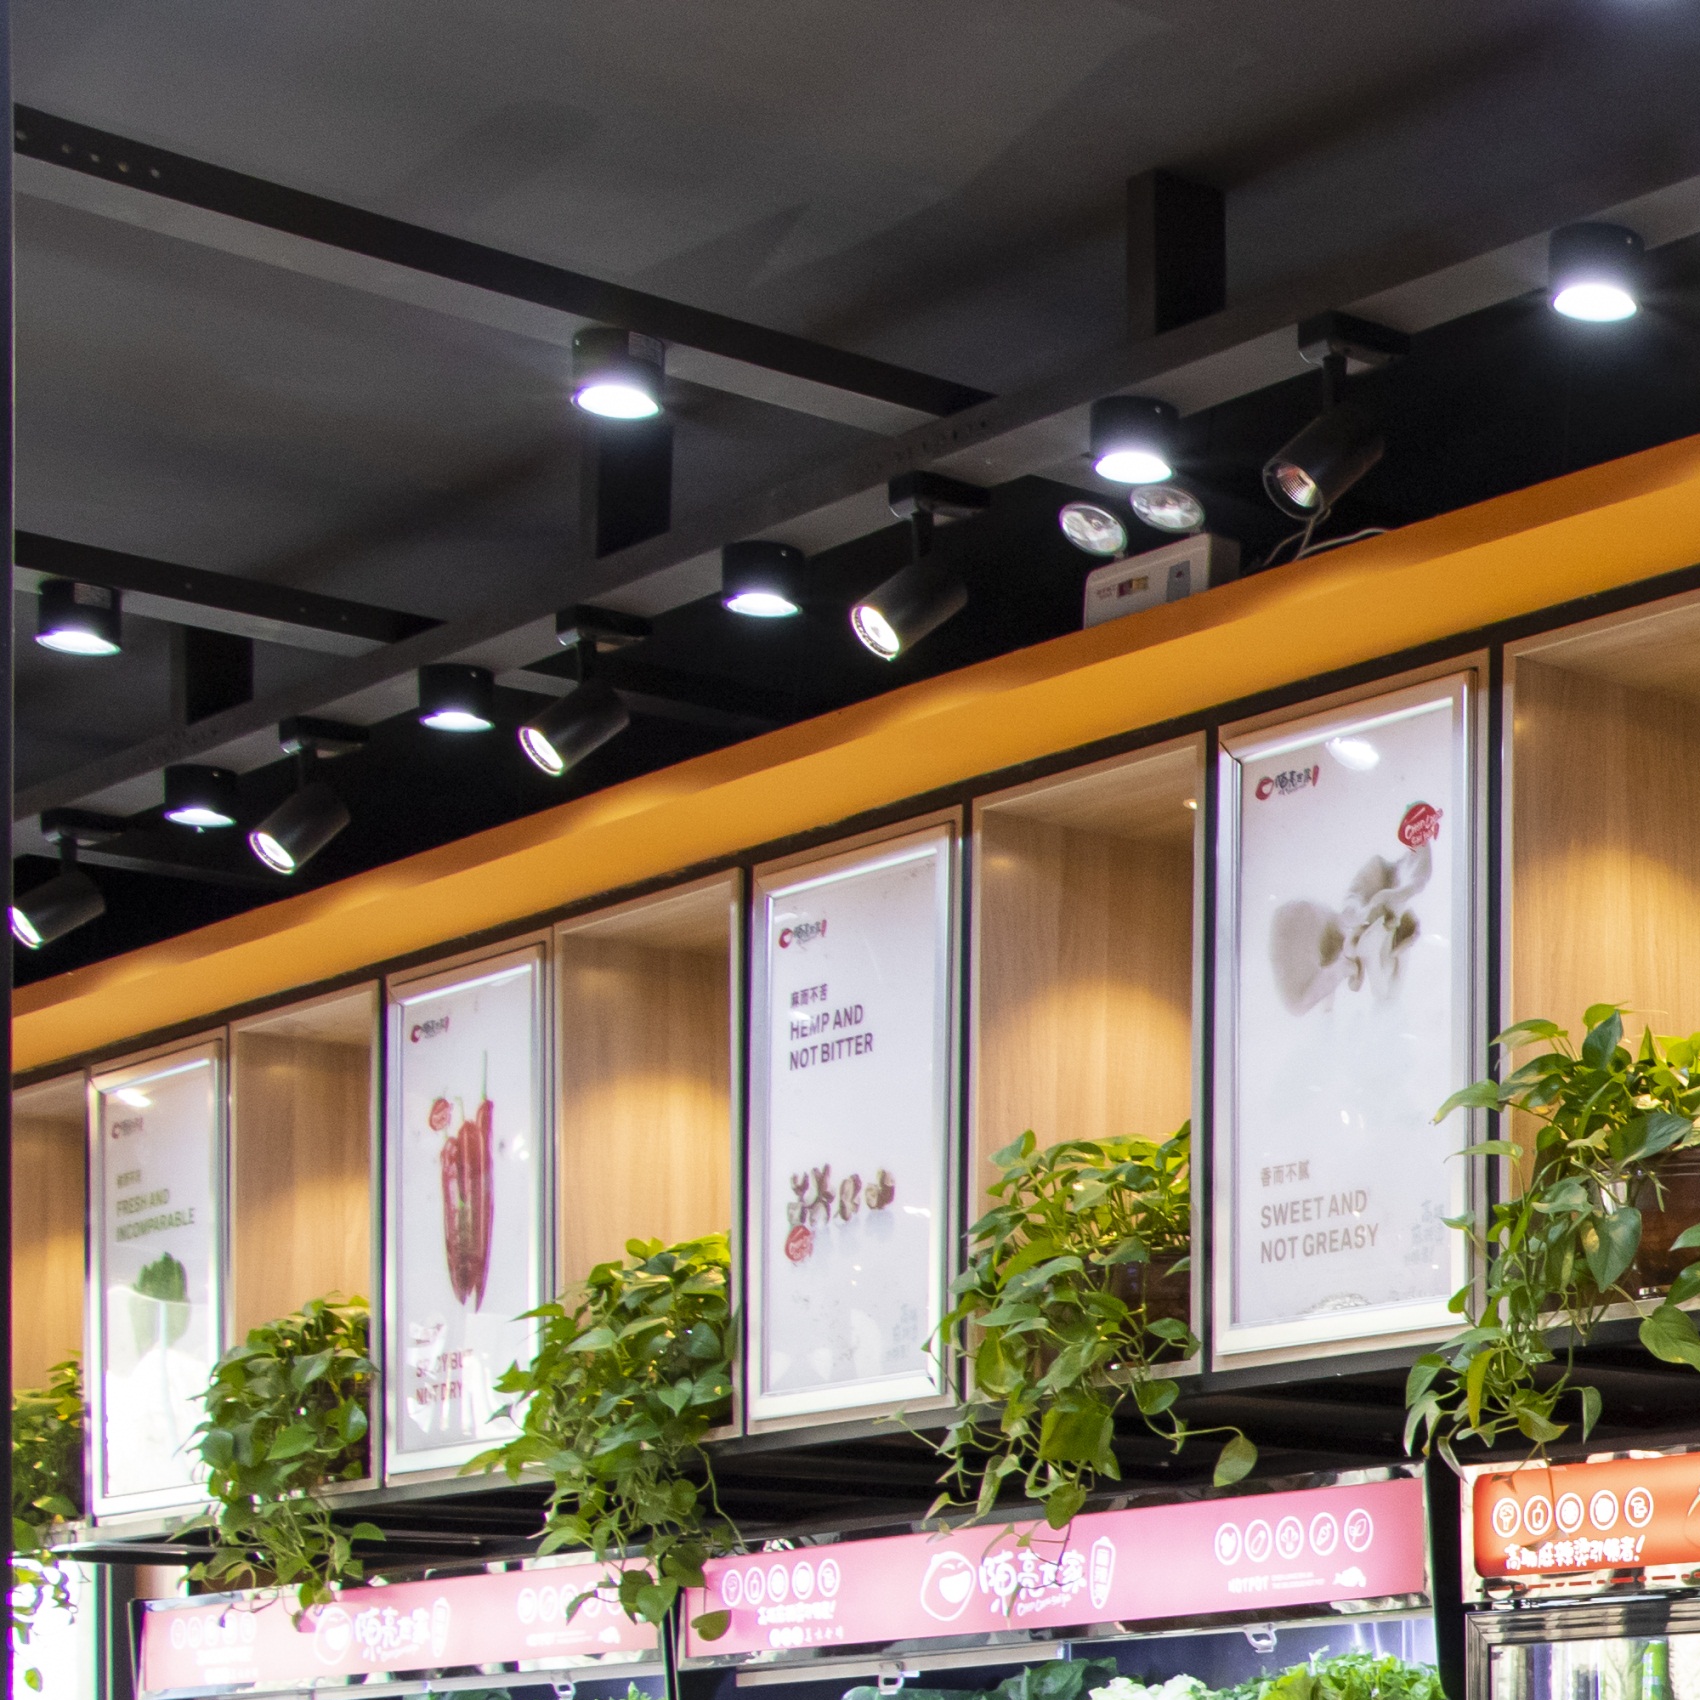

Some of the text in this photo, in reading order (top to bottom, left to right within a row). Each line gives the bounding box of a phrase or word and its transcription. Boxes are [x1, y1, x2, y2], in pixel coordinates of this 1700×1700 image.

[790, 1004, 864, 1041] HEMP AND
[789, 1032, 874, 1071] NOT BITTER
[1260, 1189, 1368, 1230] SWEET AND
[1260, 1236, 1298, 1264] NOT
[1302, 1222, 1379, 1257] GREASY
